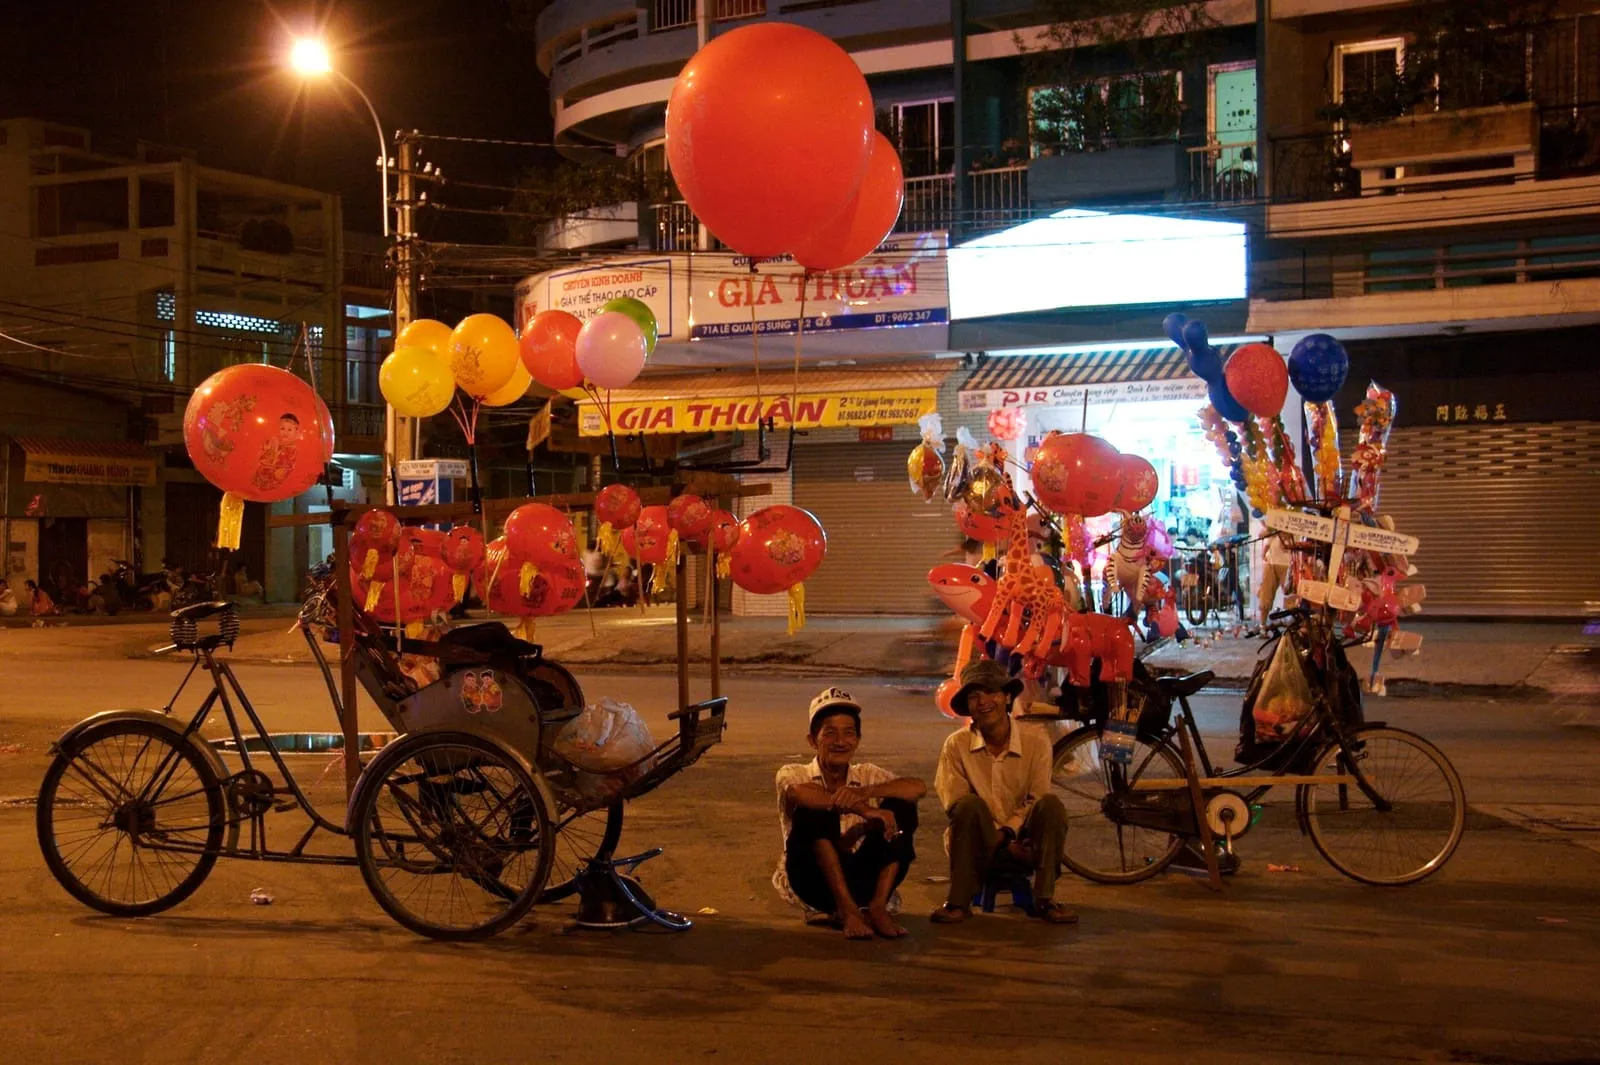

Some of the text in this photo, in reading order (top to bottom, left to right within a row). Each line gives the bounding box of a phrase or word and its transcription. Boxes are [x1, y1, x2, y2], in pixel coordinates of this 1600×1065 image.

[612, 271, 643, 284] DOANH
[592, 290, 613, 302] THAO
[615, 289, 635, 299] CAO
[718, 273, 783, 308] GIA
[766, 320, 791, 331] SUNG
[891, 312, 913, 322] 9692
[616, 406, 674, 430] GIA
